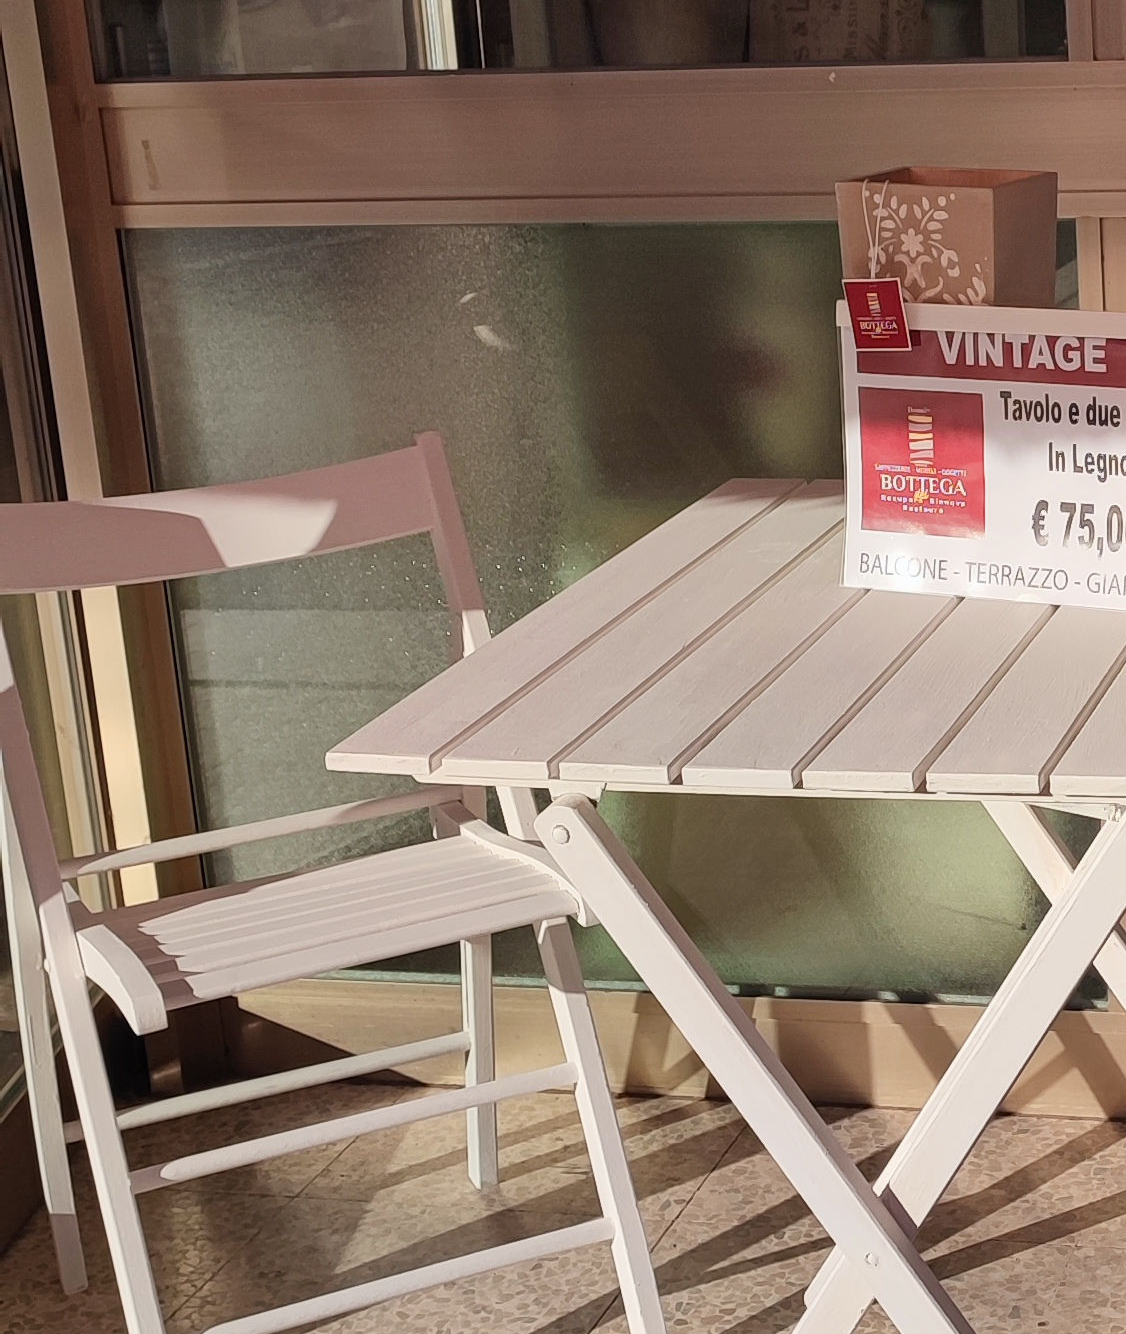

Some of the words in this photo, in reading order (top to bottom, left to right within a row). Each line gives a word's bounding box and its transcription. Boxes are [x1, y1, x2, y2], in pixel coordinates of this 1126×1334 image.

[936, 331, 1108, 373] VINTAGE
[999, 390, 1063, 425] Tavolo
[1068, 401, 1080, 425] e
[1086, 396, 1121, 428] due
[1048, 441, 1066, 473] In
[880, 473, 967, 496] BOTTEGA
[1031, 499, 1050, 548] €
[859, 552, 948, 582] BALCONE
[965, 561, 1069, 591] TERRAZZO
